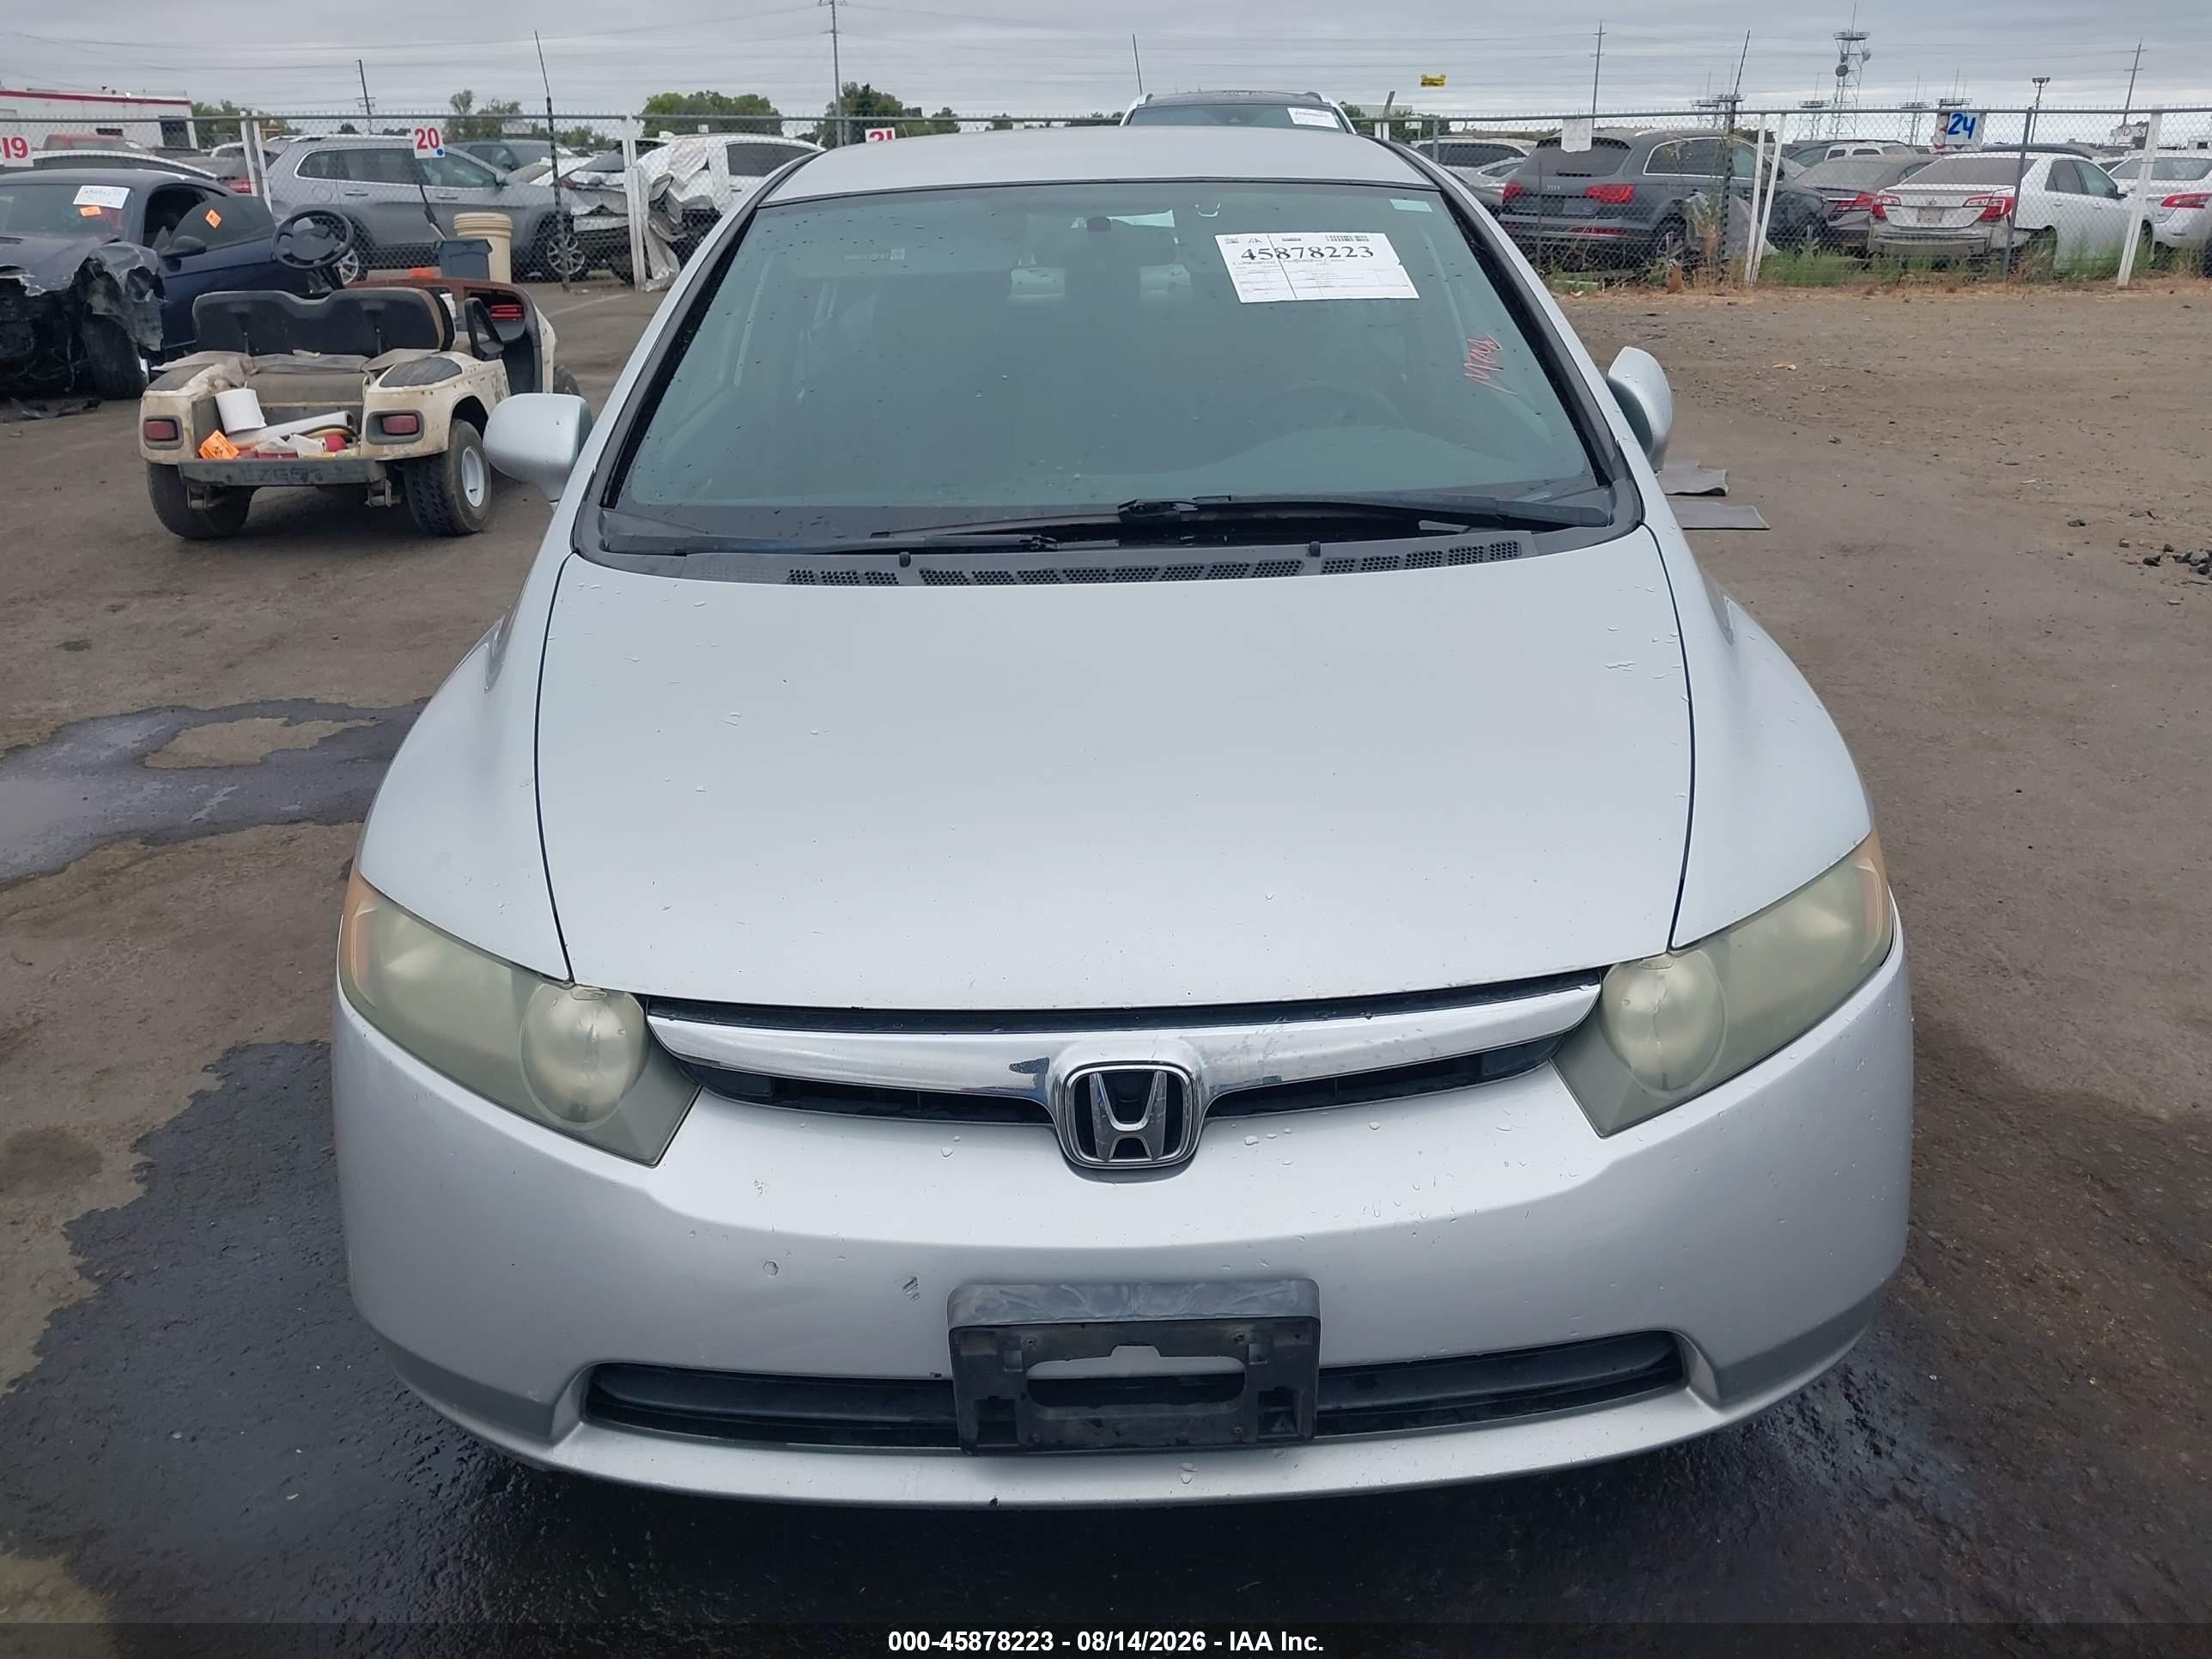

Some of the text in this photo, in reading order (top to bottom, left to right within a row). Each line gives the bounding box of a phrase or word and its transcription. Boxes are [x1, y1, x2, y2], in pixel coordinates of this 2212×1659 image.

[1948, 112, 1977, 139] 24
[2, 137, 28, 159] 19
[415, 127, 441, 150] 20
[1241, 246, 1375, 261] 45878223
